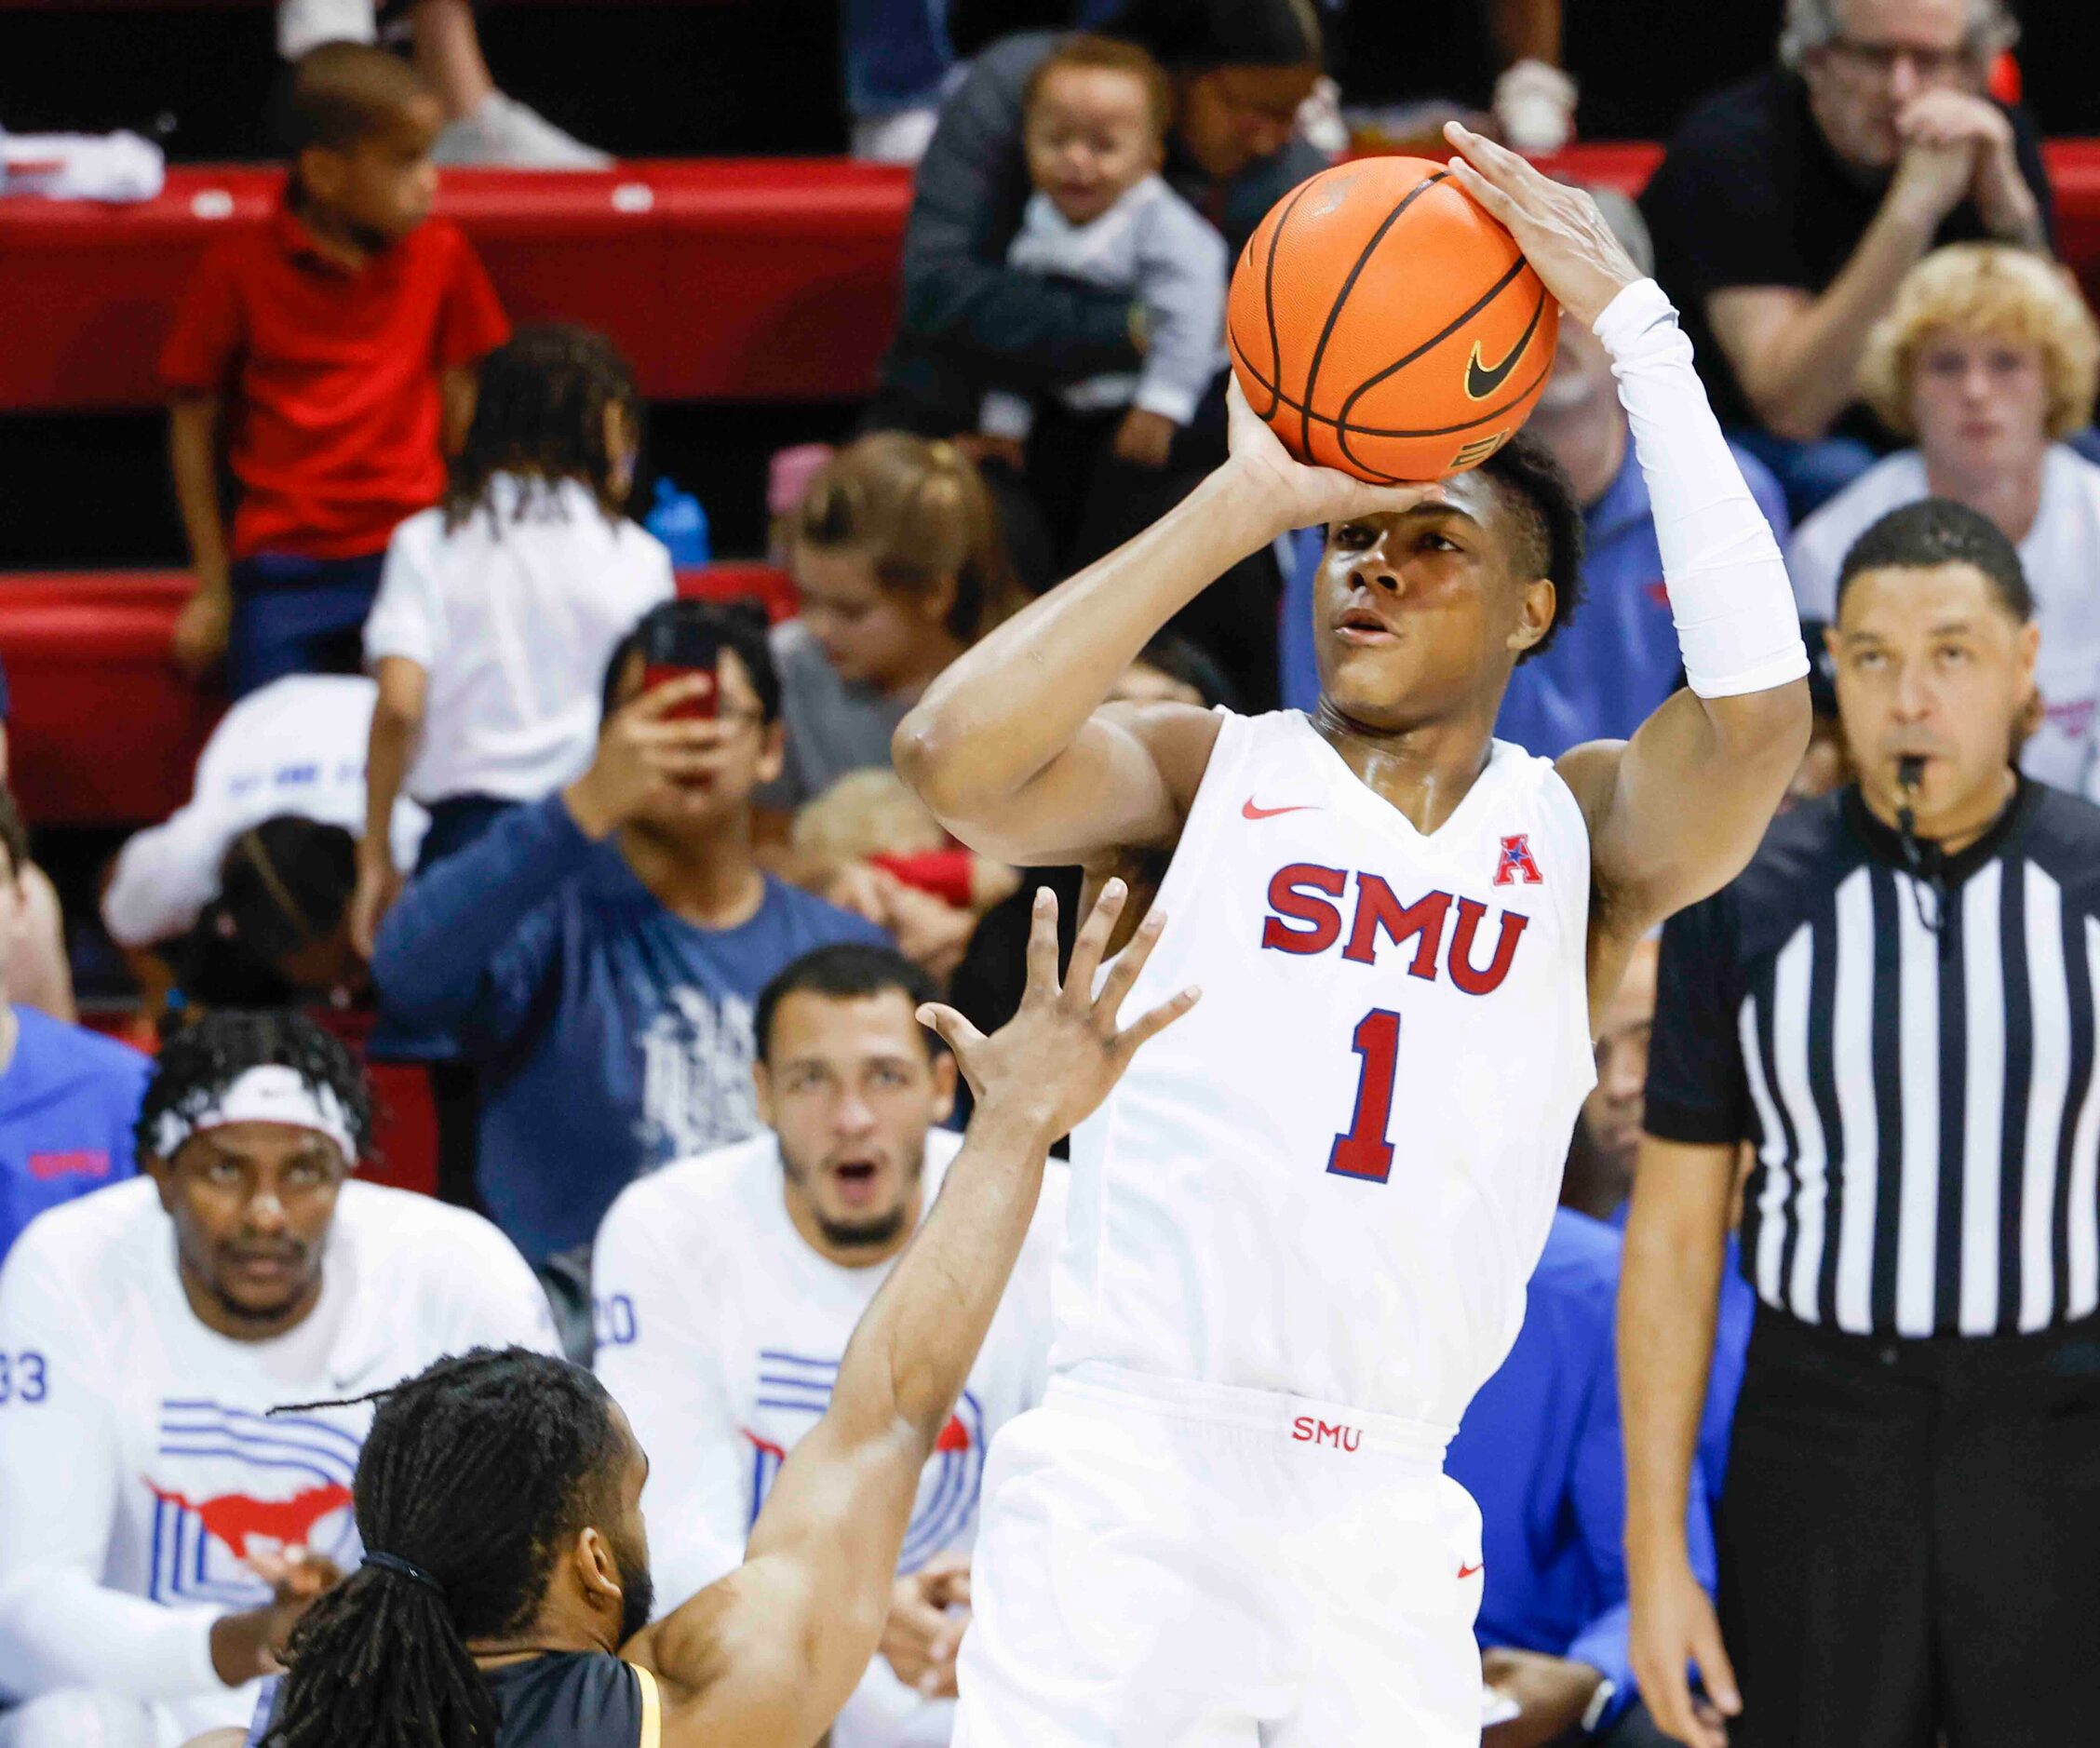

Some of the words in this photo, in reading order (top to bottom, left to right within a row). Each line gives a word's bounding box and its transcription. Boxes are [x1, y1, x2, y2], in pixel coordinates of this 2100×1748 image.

[1261, 863, 1529, 996] SMU
[1326, 1007, 1401, 1184] 1
[1291, 1416, 1364, 1452] SMU
